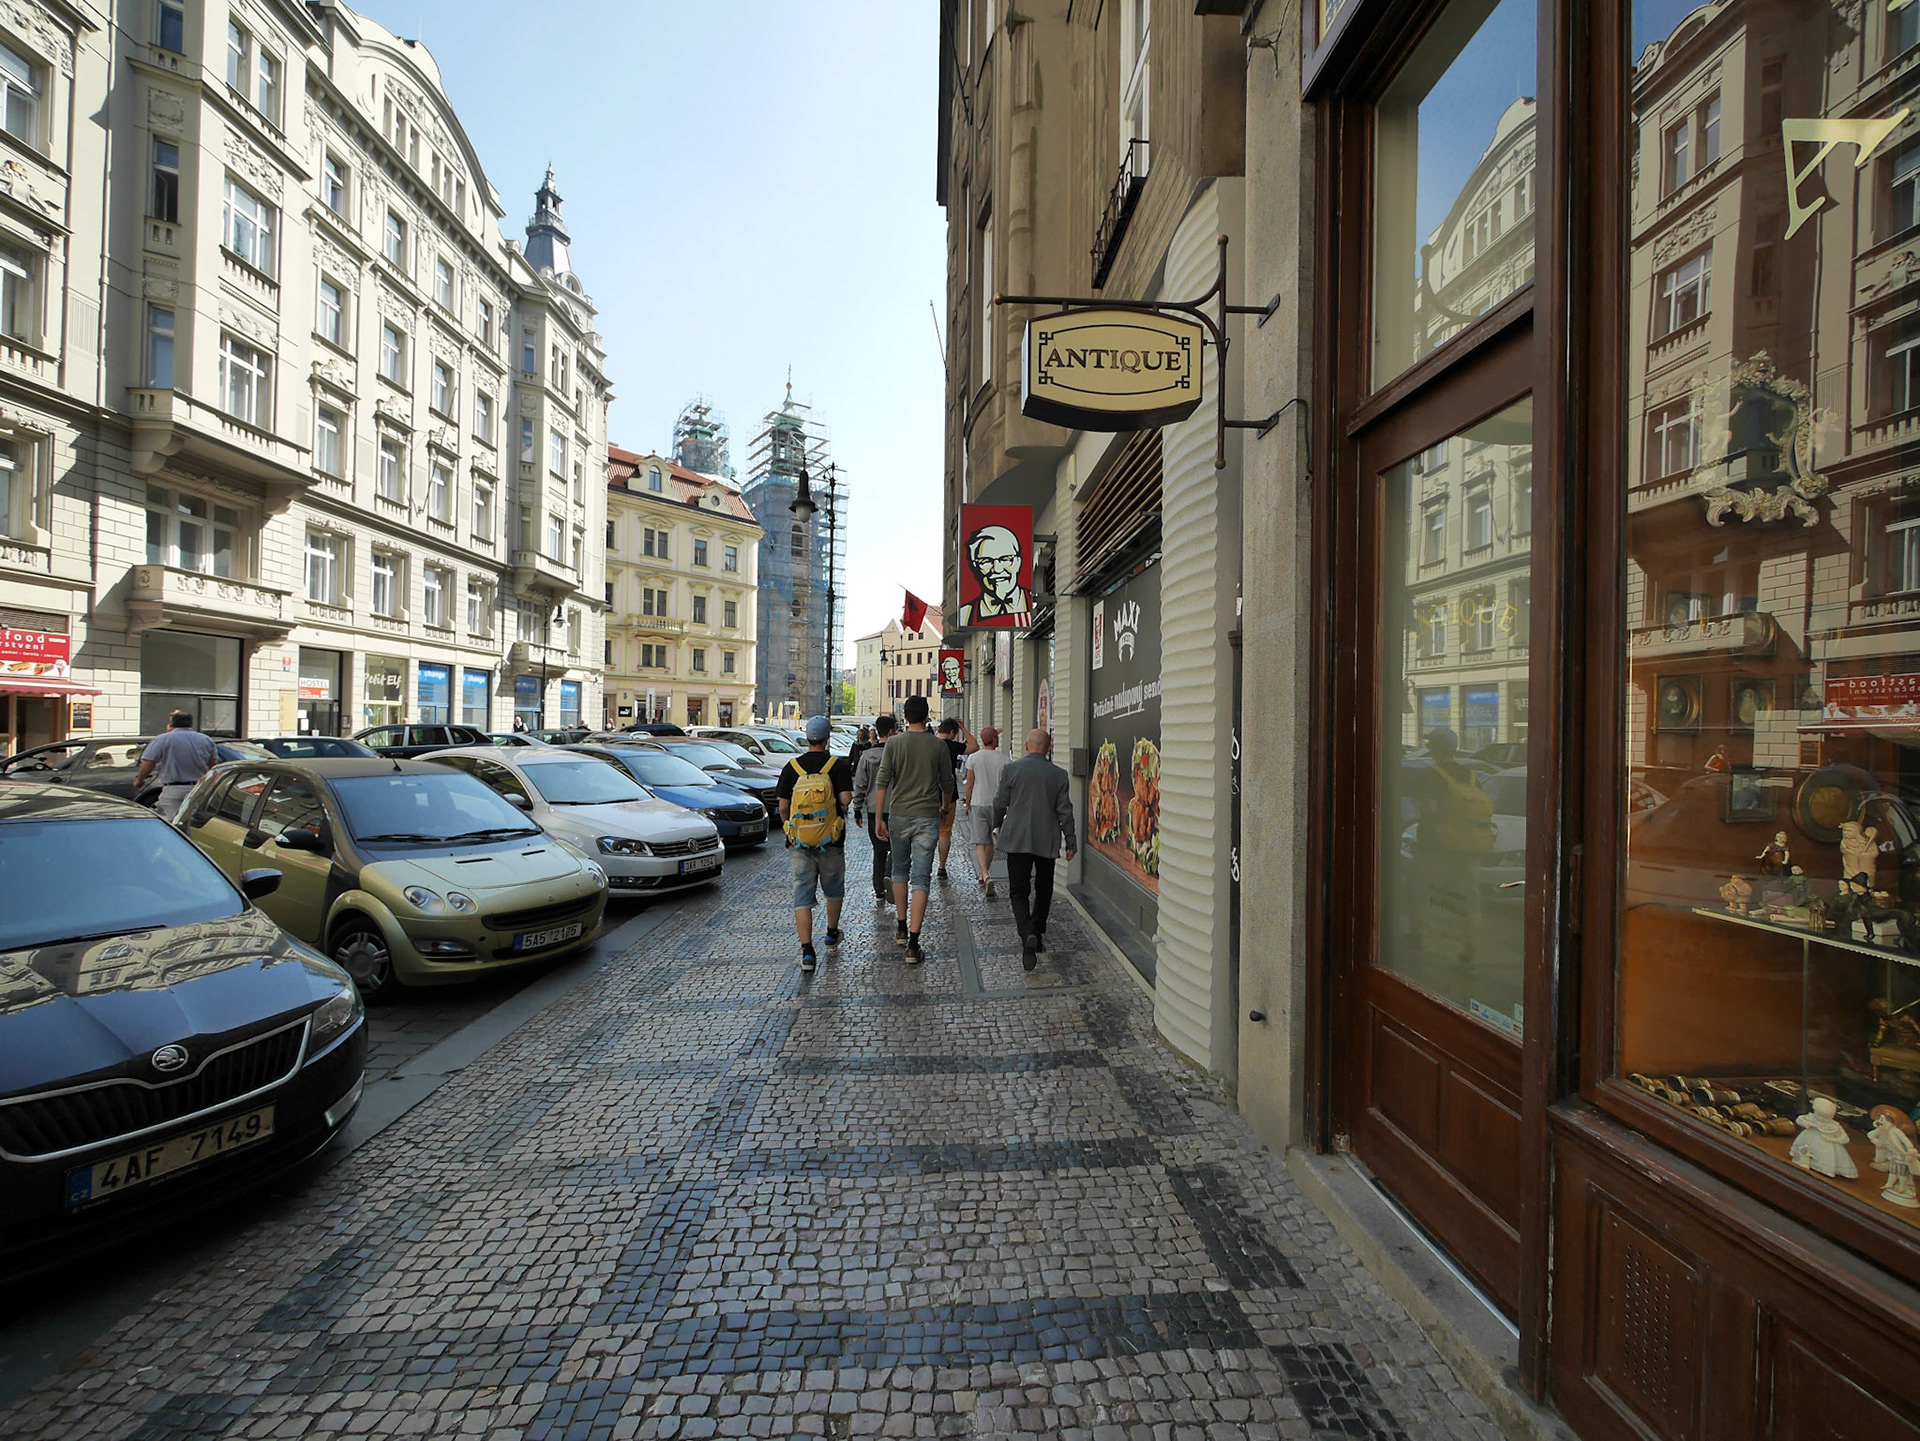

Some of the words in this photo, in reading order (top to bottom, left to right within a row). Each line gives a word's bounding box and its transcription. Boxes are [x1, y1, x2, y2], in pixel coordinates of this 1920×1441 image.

[1045, 348, 1182, 373] ANTIQUE
[1113, 600, 1141, 642] MAXI
[0, 630, 45, 643] food
[301, 679, 328, 688] HOSTEL
[387, 674, 402, 689] Elf
[525, 933, 546, 947] 5A5
[553, 925, 578, 942] 2175
[101, 1146, 164, 1189] 4AF
[190, 1113, 261, 1161] 7149
[71, 1189, 88, 1202] CZ
